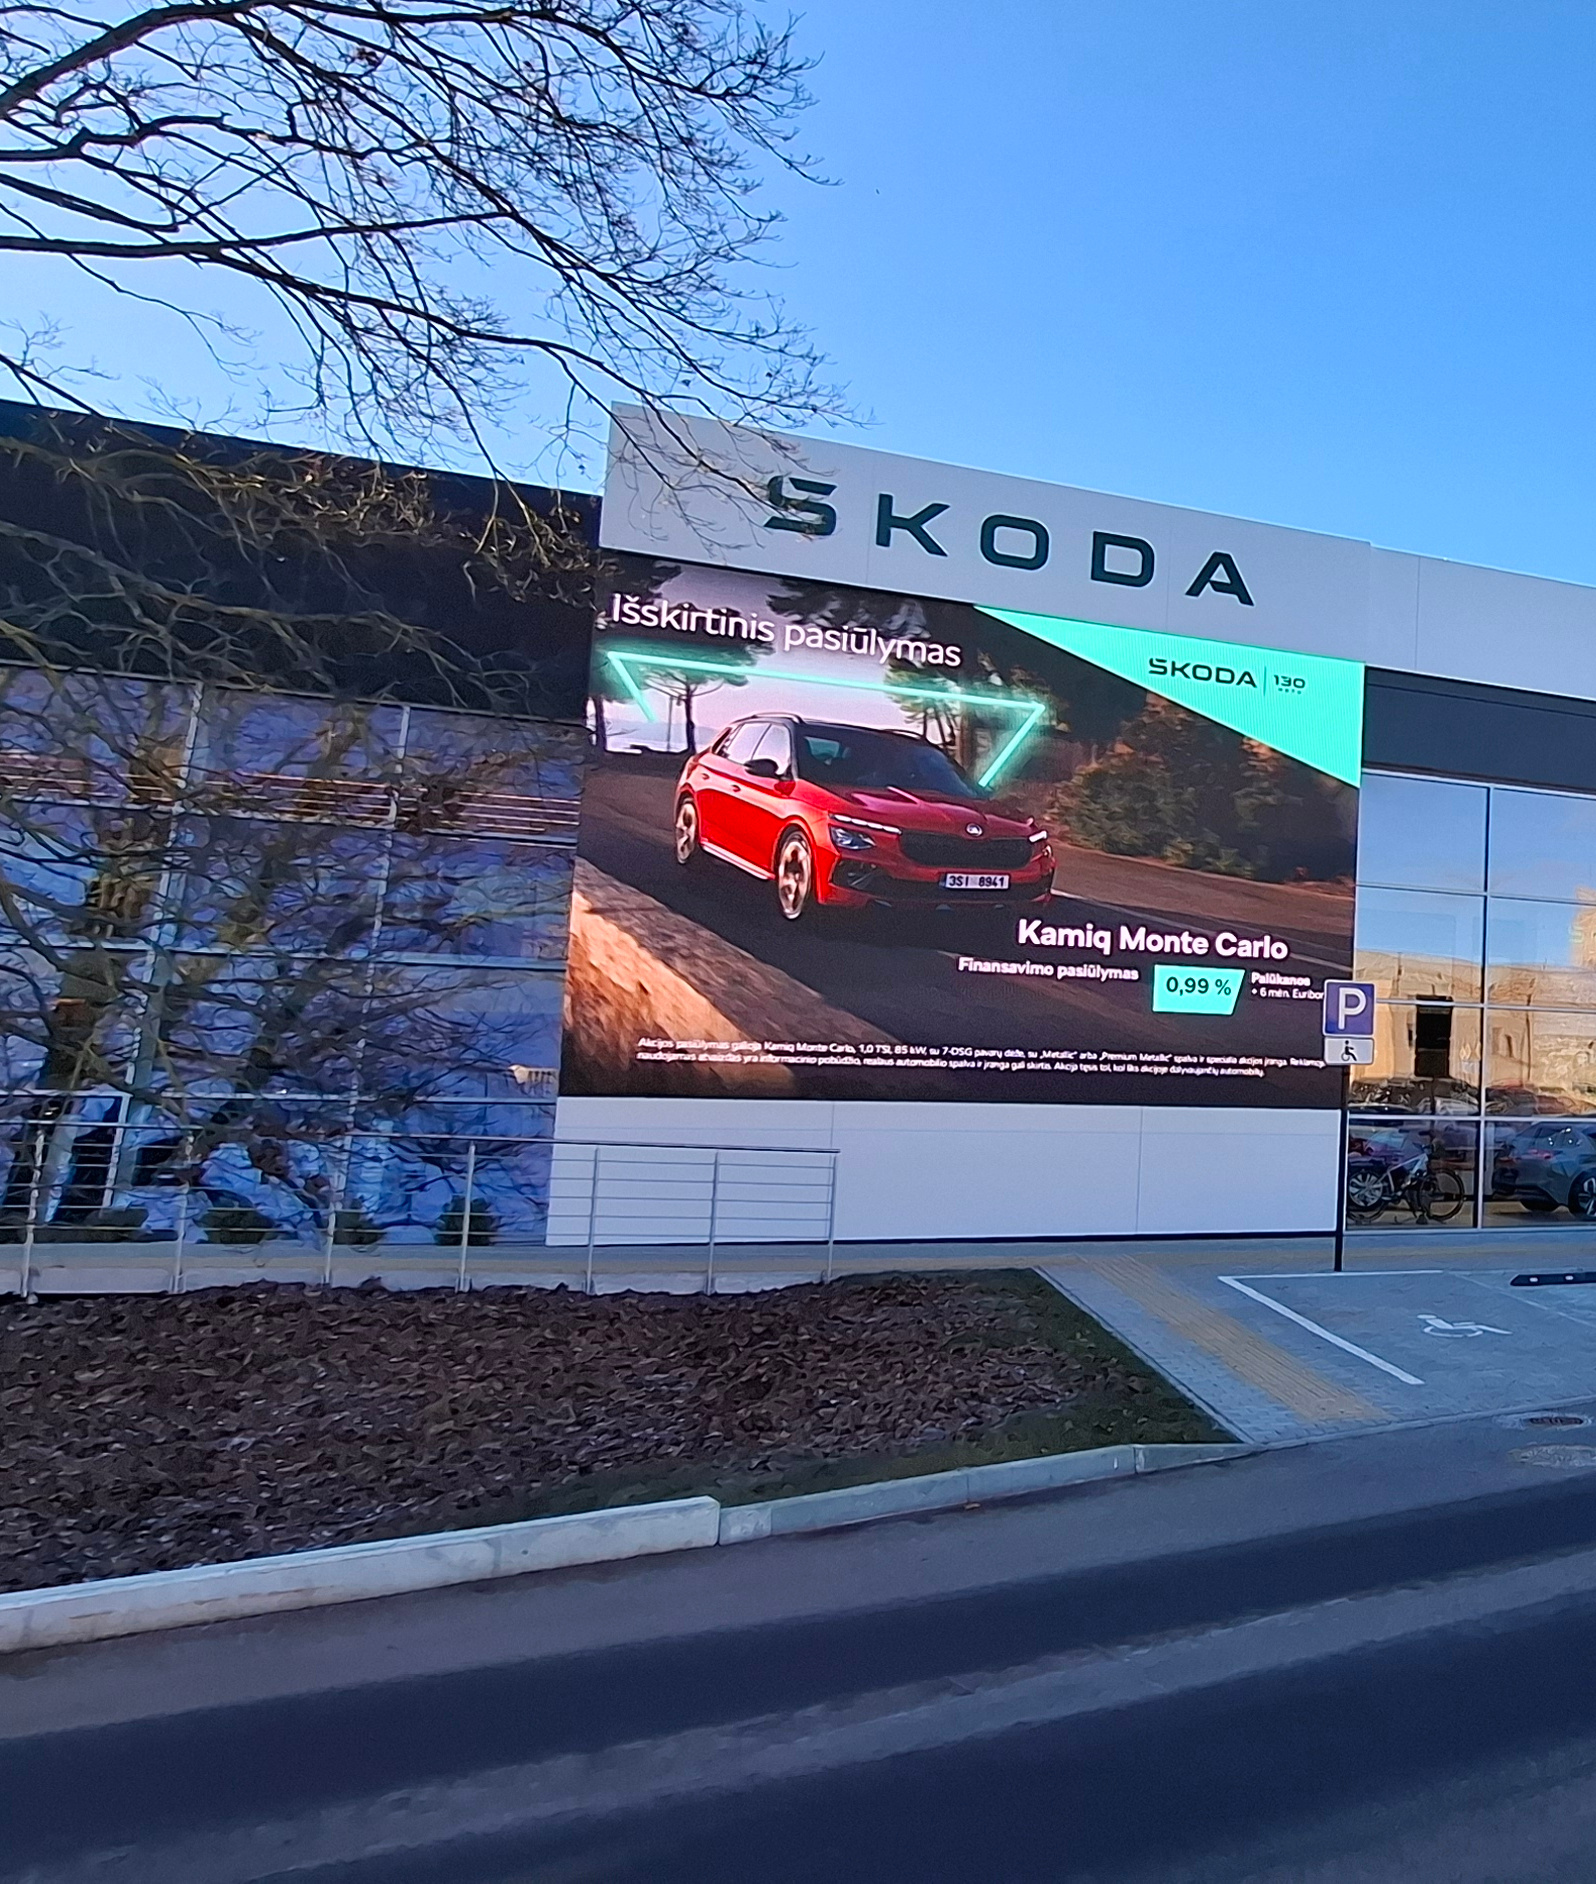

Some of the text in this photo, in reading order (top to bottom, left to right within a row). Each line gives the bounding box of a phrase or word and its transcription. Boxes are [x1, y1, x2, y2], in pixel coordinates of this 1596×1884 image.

[612, 592, 962, 667] Išskirtinis pasiūlymas
[1273, 674, 1306, 689] 130
[1017, 918, 1289, 960] Kamiq Monte Carlo
[958, 956, 1140, 983] Finansavimo pasiūlymas
[1259, 987, 1267, 998] 6
[1338, 986, 1367, 1030] P
